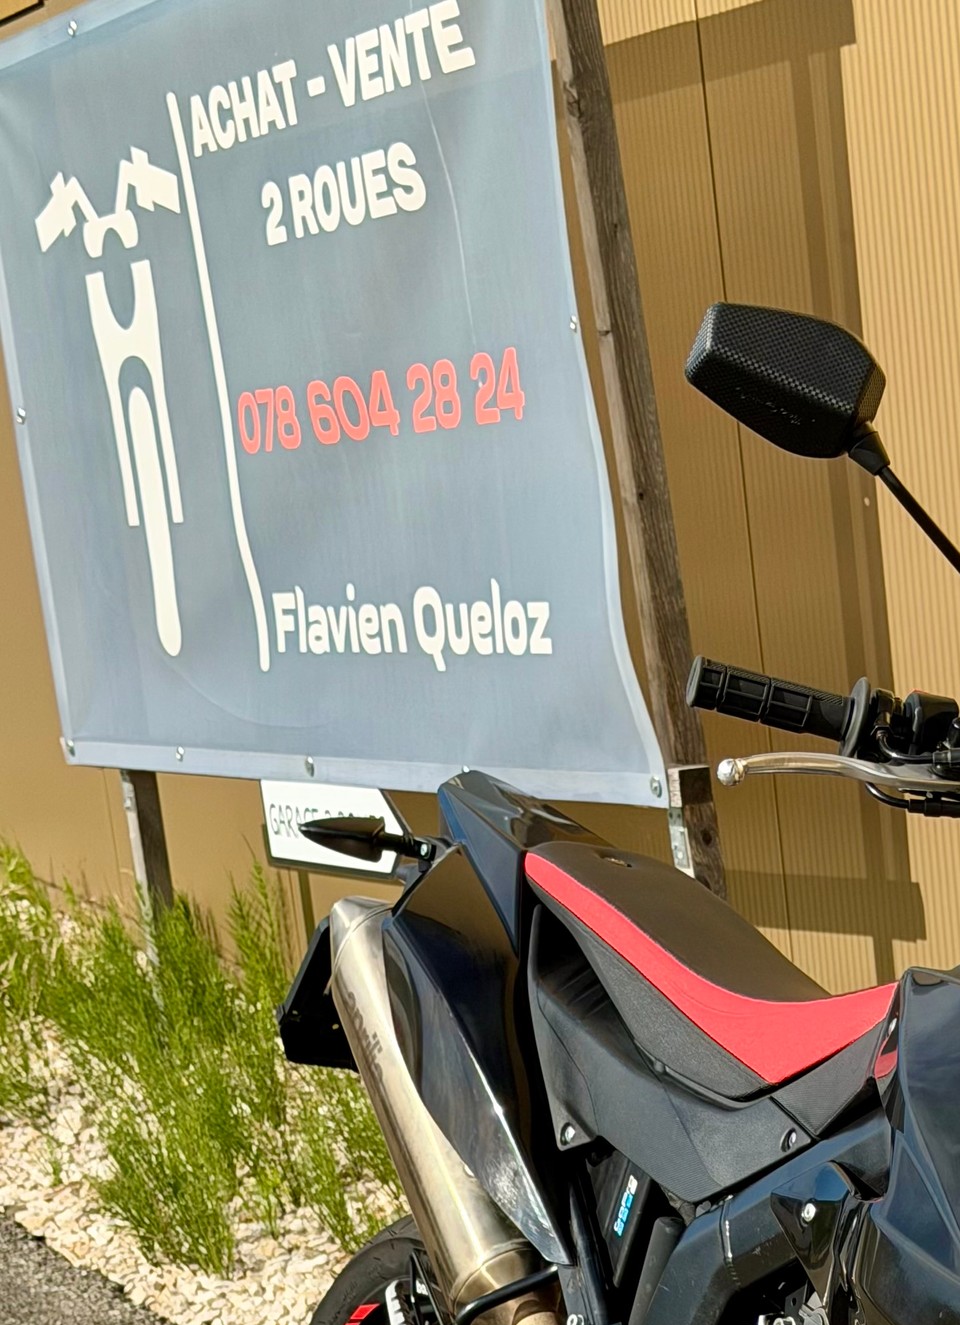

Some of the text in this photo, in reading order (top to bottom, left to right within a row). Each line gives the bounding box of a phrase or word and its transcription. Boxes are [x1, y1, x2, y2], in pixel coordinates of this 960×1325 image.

[190, 0, 476, 158] ACHAT - VENTE
[261, 142, 427, 246] 2 ROUES
[237, 347, 525, 454] 078 604 28 24
[272, 578, 553, 672] Flavien Queloz
